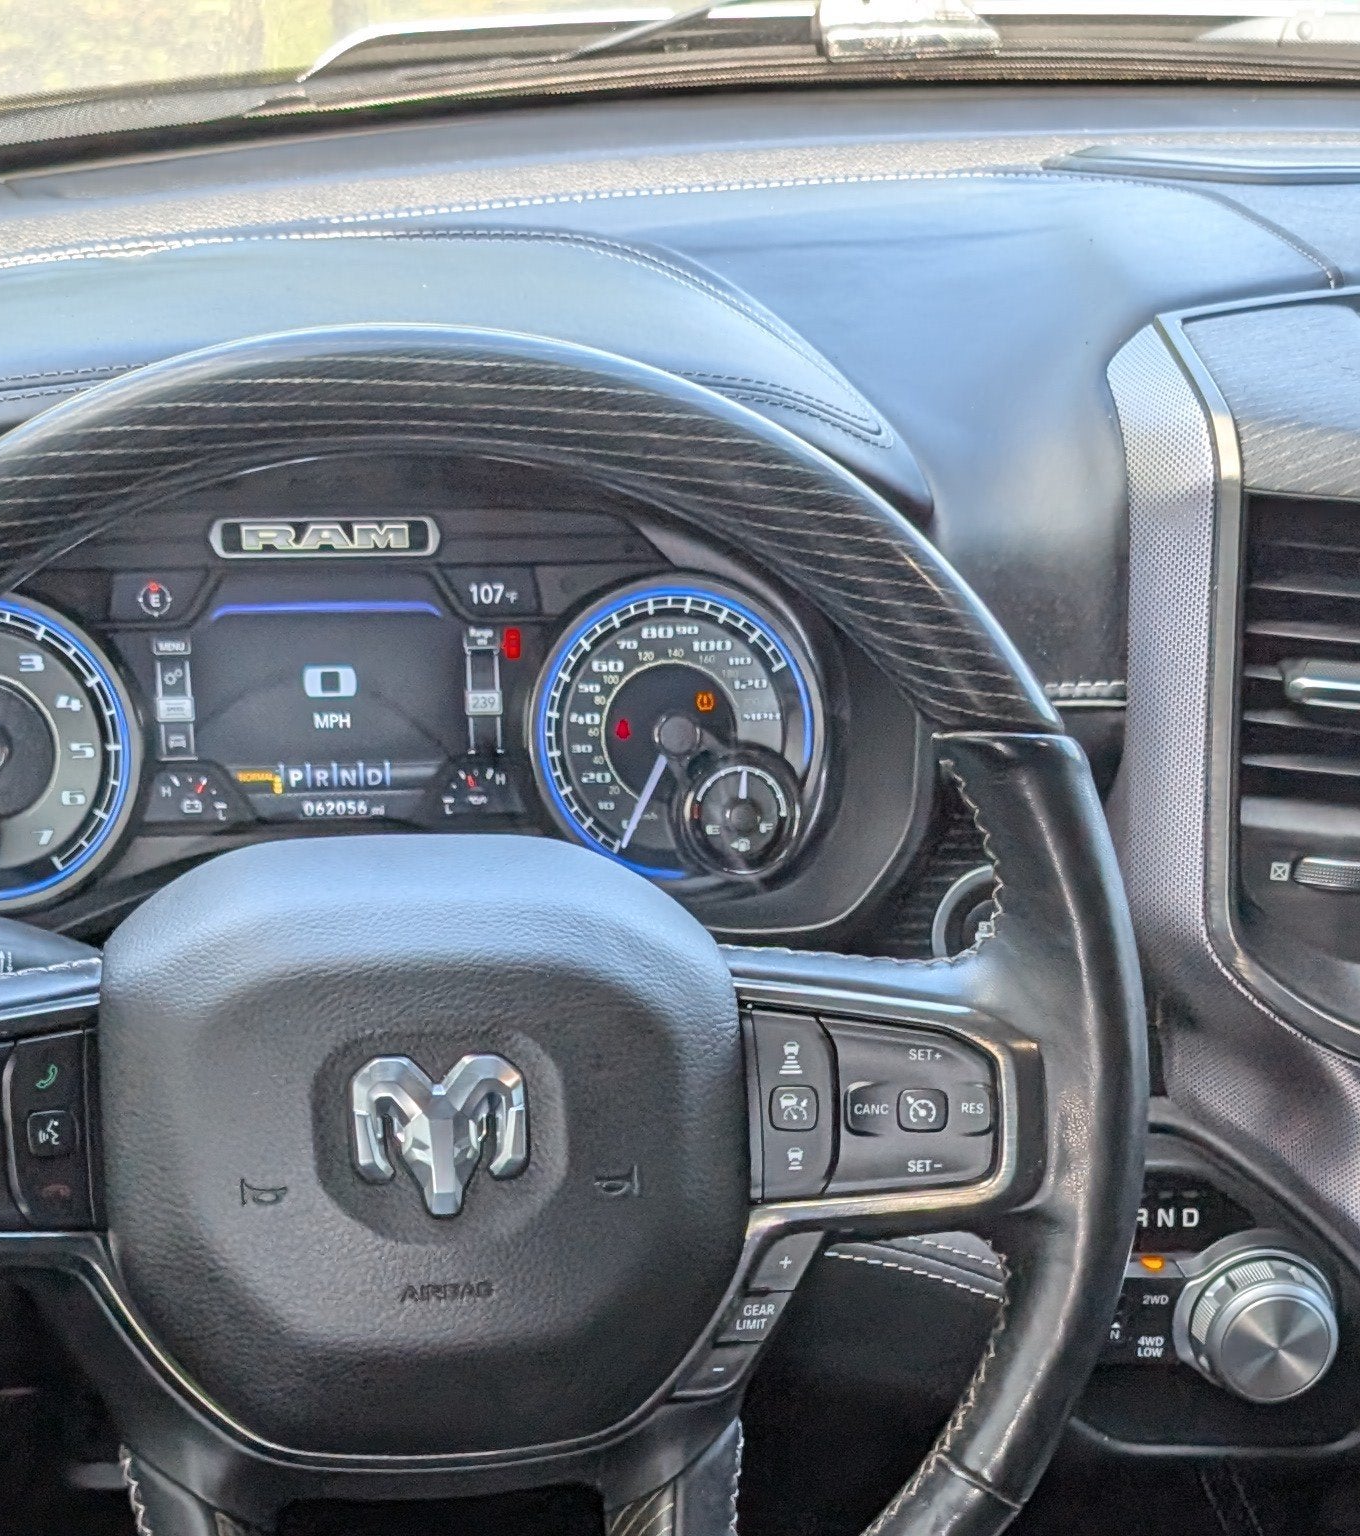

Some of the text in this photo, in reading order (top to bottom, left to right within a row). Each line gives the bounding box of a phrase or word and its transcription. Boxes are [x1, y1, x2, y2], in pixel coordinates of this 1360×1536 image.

[242, 523, 410, 551] RAM
[641, 625, 674, 639] 80
[157, 641, 185, 651] MENU
[617, 640, 638, 650] 70
[693, 640, 732, 651] 100
[18, 655, 44, 672] 3
[591, 660, 624, 673] 60
[55, 695, 83, 711] 4
[313, 713, 351, 730] MPH
[570, 713, 600, 724] 40
[70, 743, 95, 758] 5
[289, 768, 383, 787] P R N D
[581, 772, 611, 783] 20
[60, 790, 86, 806] 6
[303, 800, 368, 816] 062056
[35, 830, 56, 846] 7
[854, 1103, 889, 1116] CANC
[961, 1102, 984, 1115] RES
[1157, 1207, 1175, 1228] N
[1182, 1207, 1200, 1228] D
[401, 1281, 493, 1301] AIRBAG
[1142, 1294, 1169, 1305] 2WD
[743, 1304, 775, 1316] GEAR
[736, 1317, 768, 1330] LIMIT
[1110, 1329, 1120, 1340] N
[1137, 1336, 1165, 1346] 4WD
[1136, 1347, 1164, 1358] LOW
